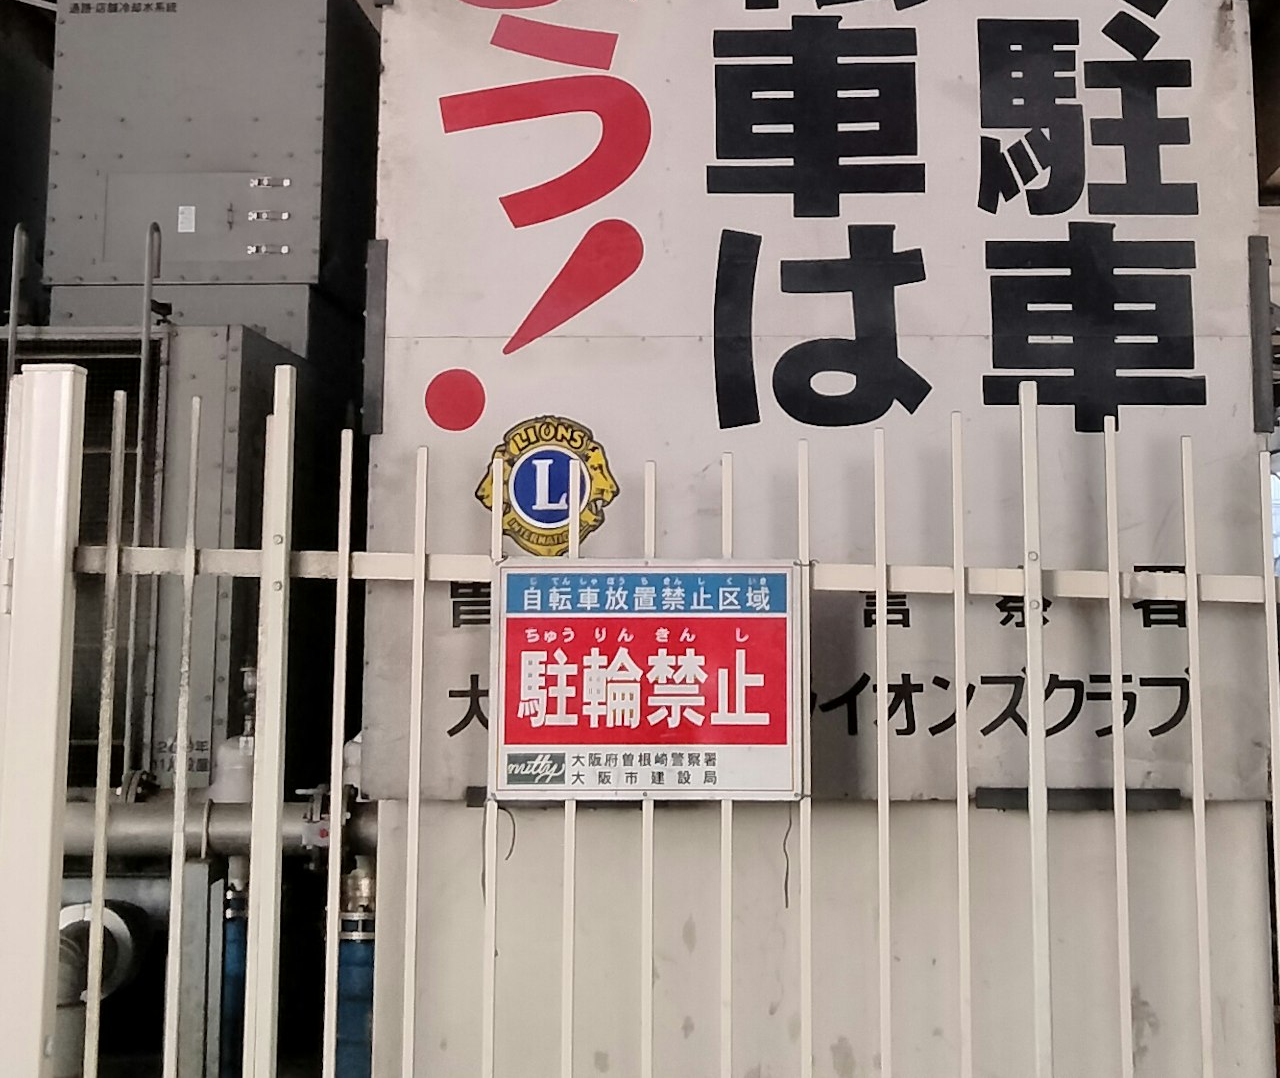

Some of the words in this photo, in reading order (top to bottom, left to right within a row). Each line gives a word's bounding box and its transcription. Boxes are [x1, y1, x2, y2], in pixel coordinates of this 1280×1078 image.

[512, 423, 586, 450] LIONS
[531, 459, 568, 510] L
[508, 518, 570, 546] INTERNATIO
[522, 586, 771, 612] 自転車放置禁止区域
[516, 646, 771, 729] 駐輪禁止
[811, 666, 1192, 738] イオンズクラブ
[571, 771, 718, 786] 大阪市建設局
